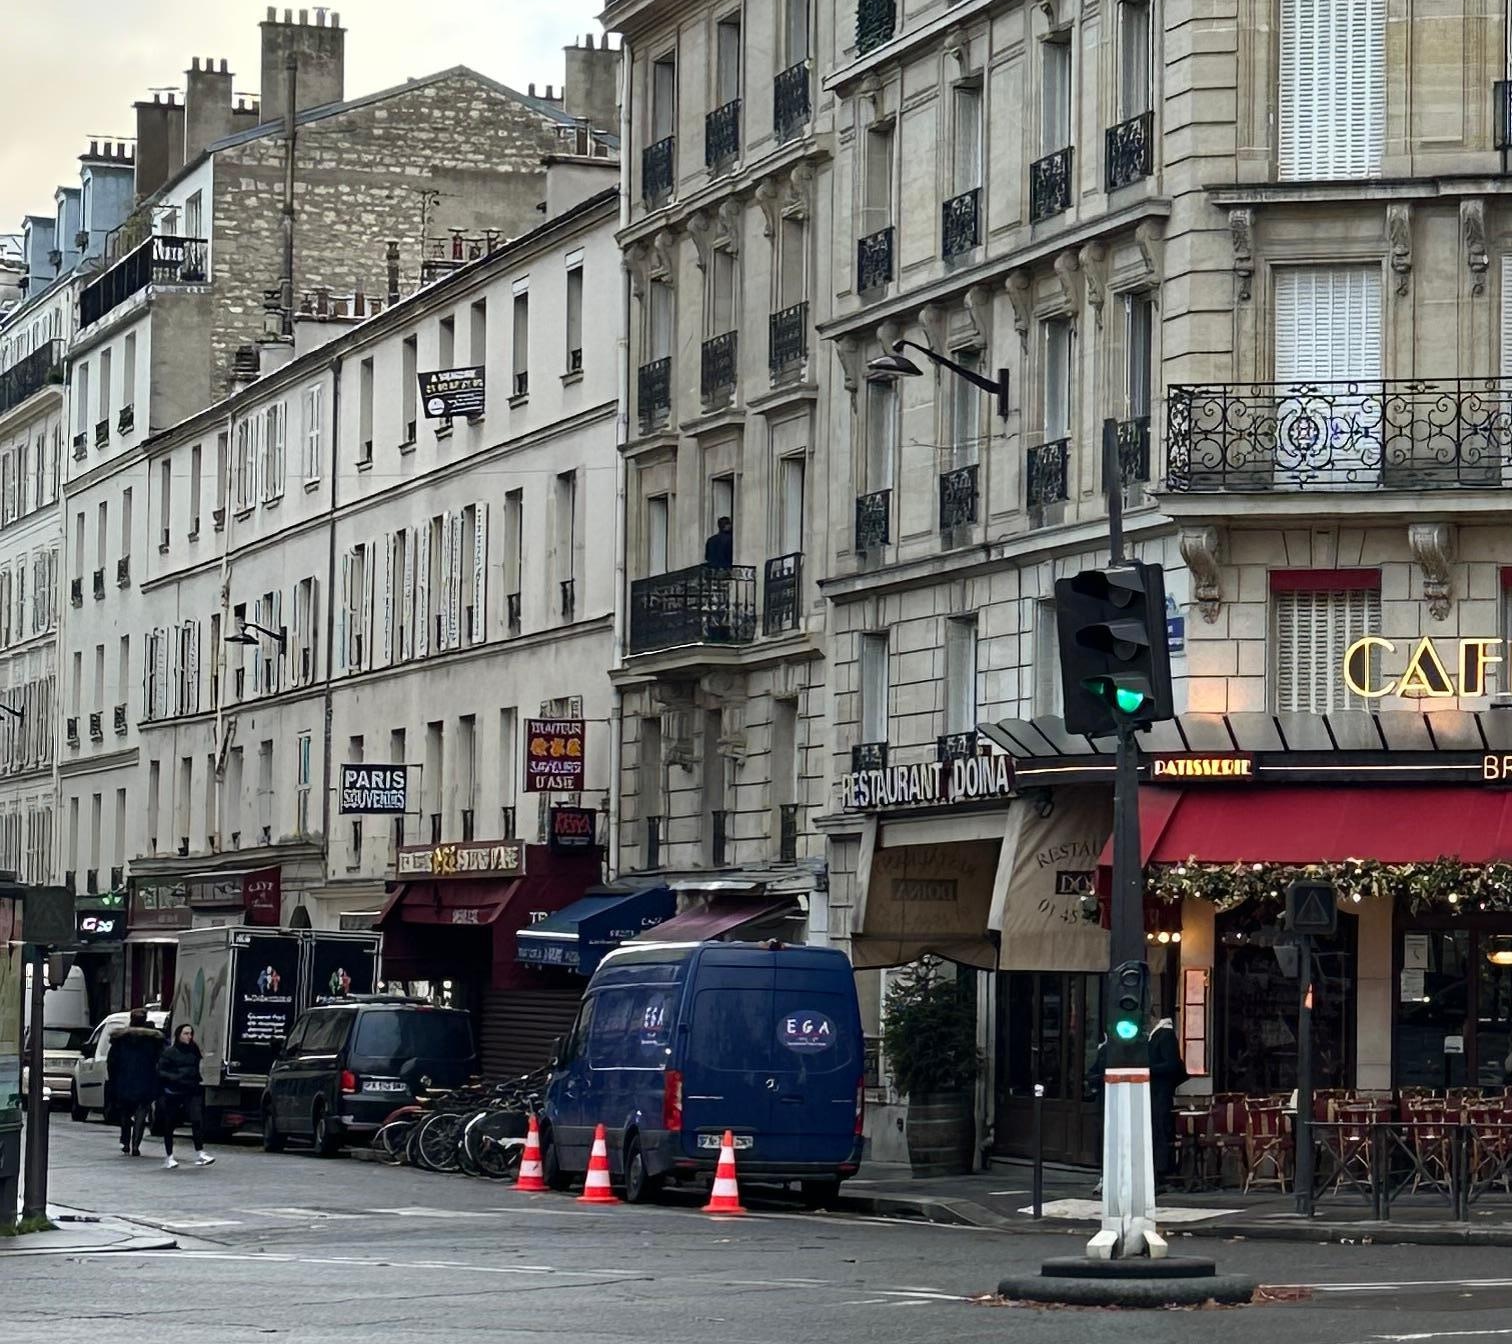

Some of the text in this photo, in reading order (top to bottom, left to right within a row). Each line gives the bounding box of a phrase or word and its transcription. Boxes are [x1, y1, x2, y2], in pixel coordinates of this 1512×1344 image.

[344, 770, 405, 789] PARIS
[841, 755, 1010, 807] RESTAURANT DOINA
[786, 1018, 830, 1035] EGA
